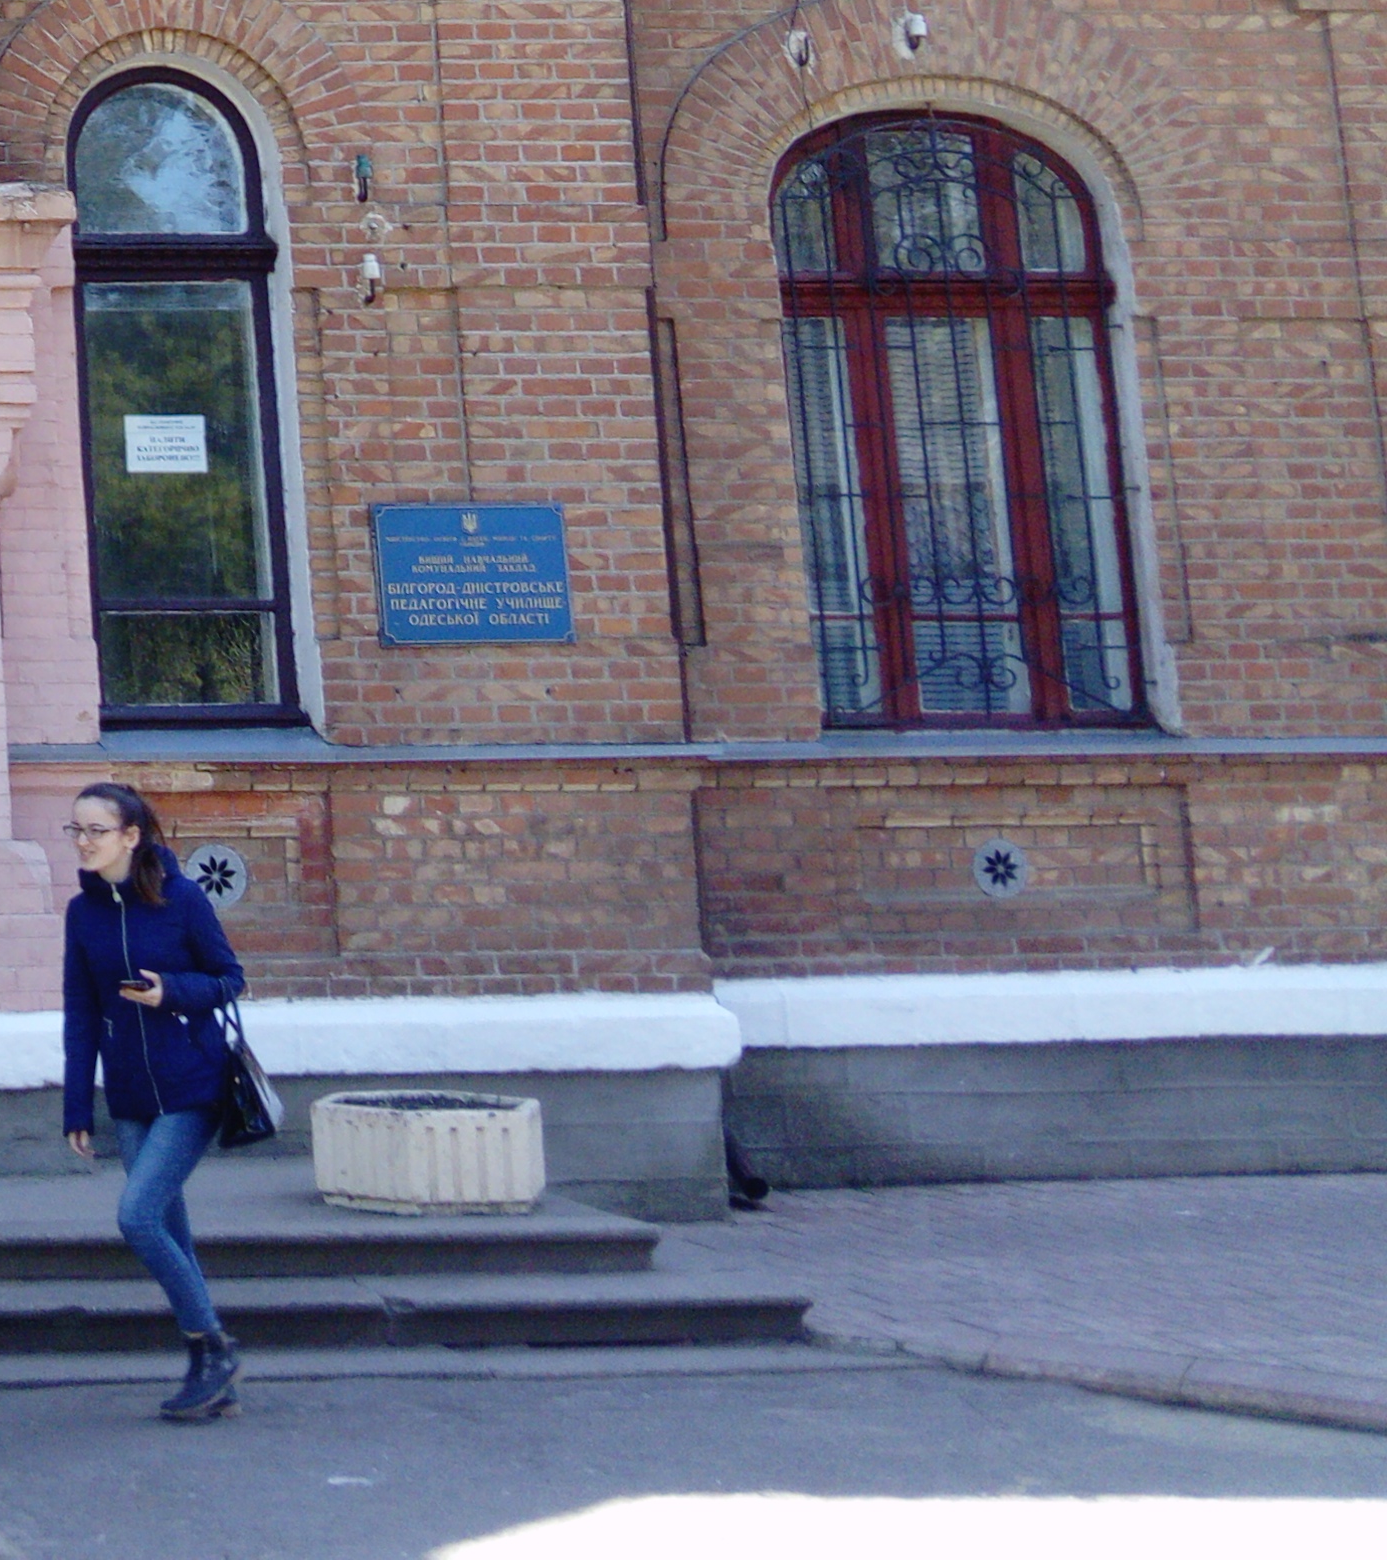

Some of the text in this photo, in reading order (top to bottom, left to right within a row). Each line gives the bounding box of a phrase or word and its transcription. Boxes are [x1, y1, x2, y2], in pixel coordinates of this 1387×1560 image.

[463, 553, 528, 564] НАВЧАЛЬНИЙ
[411, 563, 536, 573] КОМУНАЛЬНИЙ ЗАКЛАД
[388, 581, 564, 595] БІЛГОРОД-ДНІСТРОВСЬКЕ
[390, 597, 563, 610] ПЕДАГОГІЧНЕ УЧИЛИЩЕ
[408, 611, 550, 626] ОДЕСЬКОЇ ОБЛАСТІ
